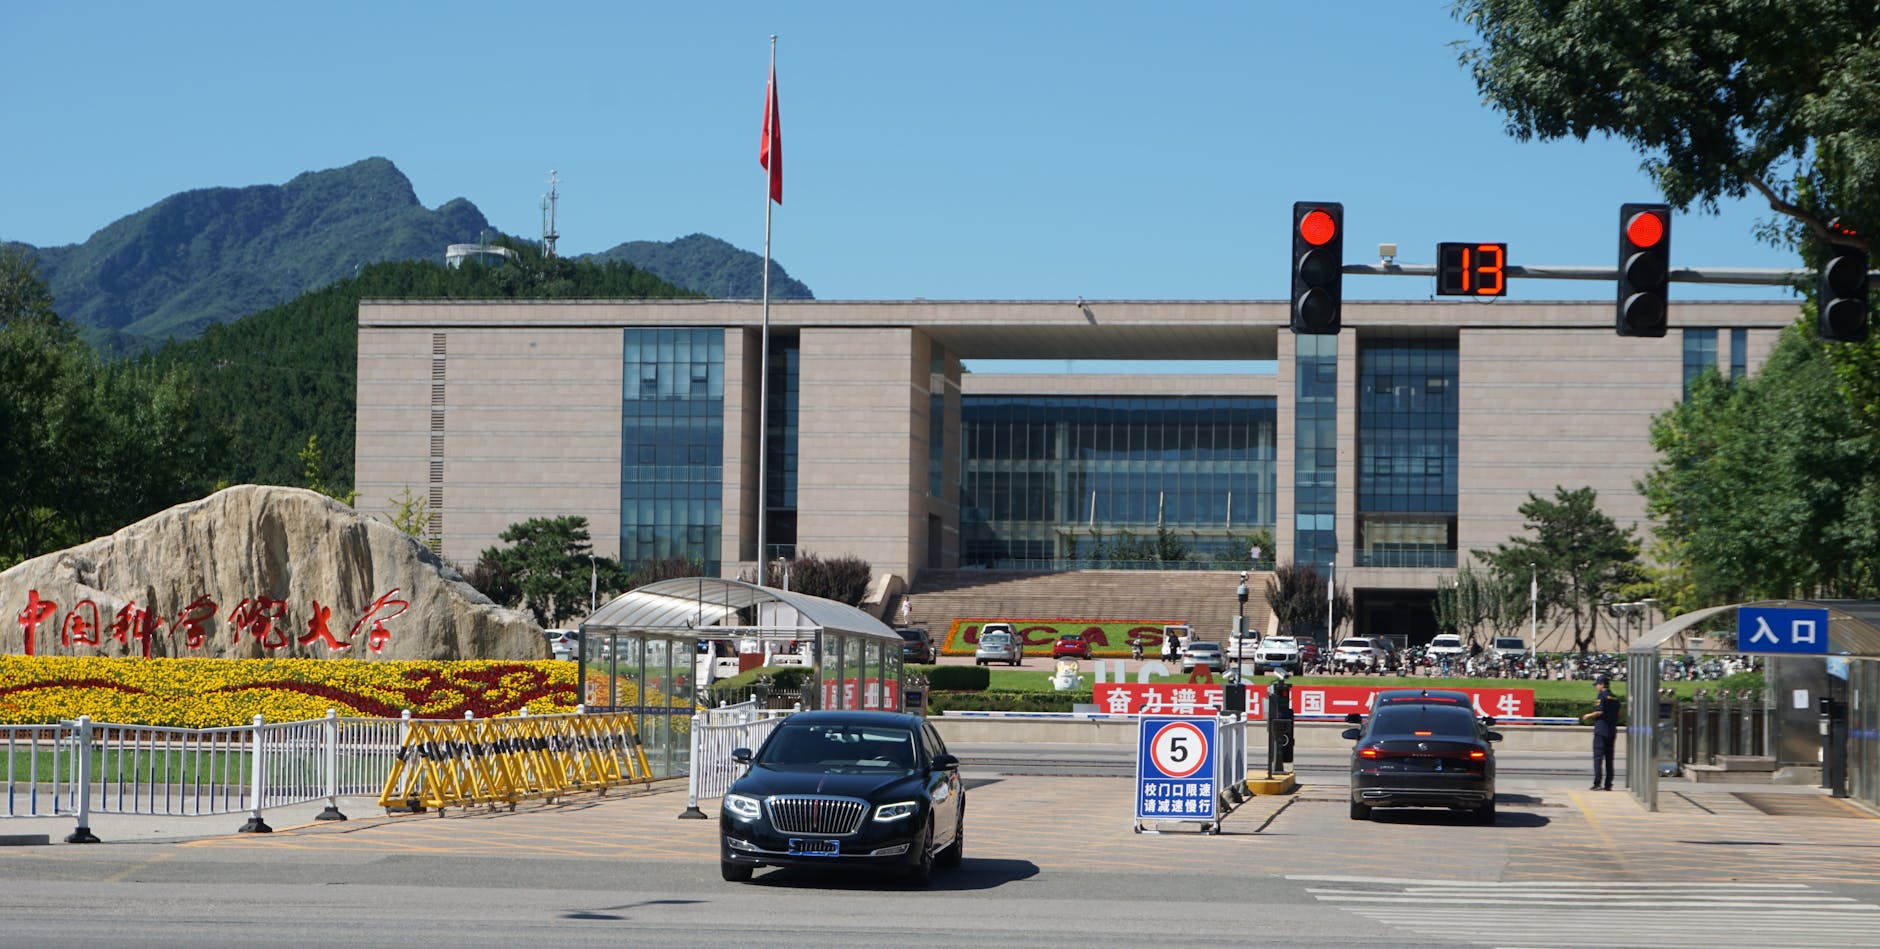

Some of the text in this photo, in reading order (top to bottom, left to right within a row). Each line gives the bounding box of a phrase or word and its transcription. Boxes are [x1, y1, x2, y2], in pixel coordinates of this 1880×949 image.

[1462, 244, 1503, 295] 13
[17, 588, 409, 659] 中国科学院大学
[1749, 615, 1816, 644] 入口
[1170, 737, 1188, 762] 5
[1144, 782, 1212, 798] 校门口限速
[1144, 798, 1211, 813] 请减速慢行
